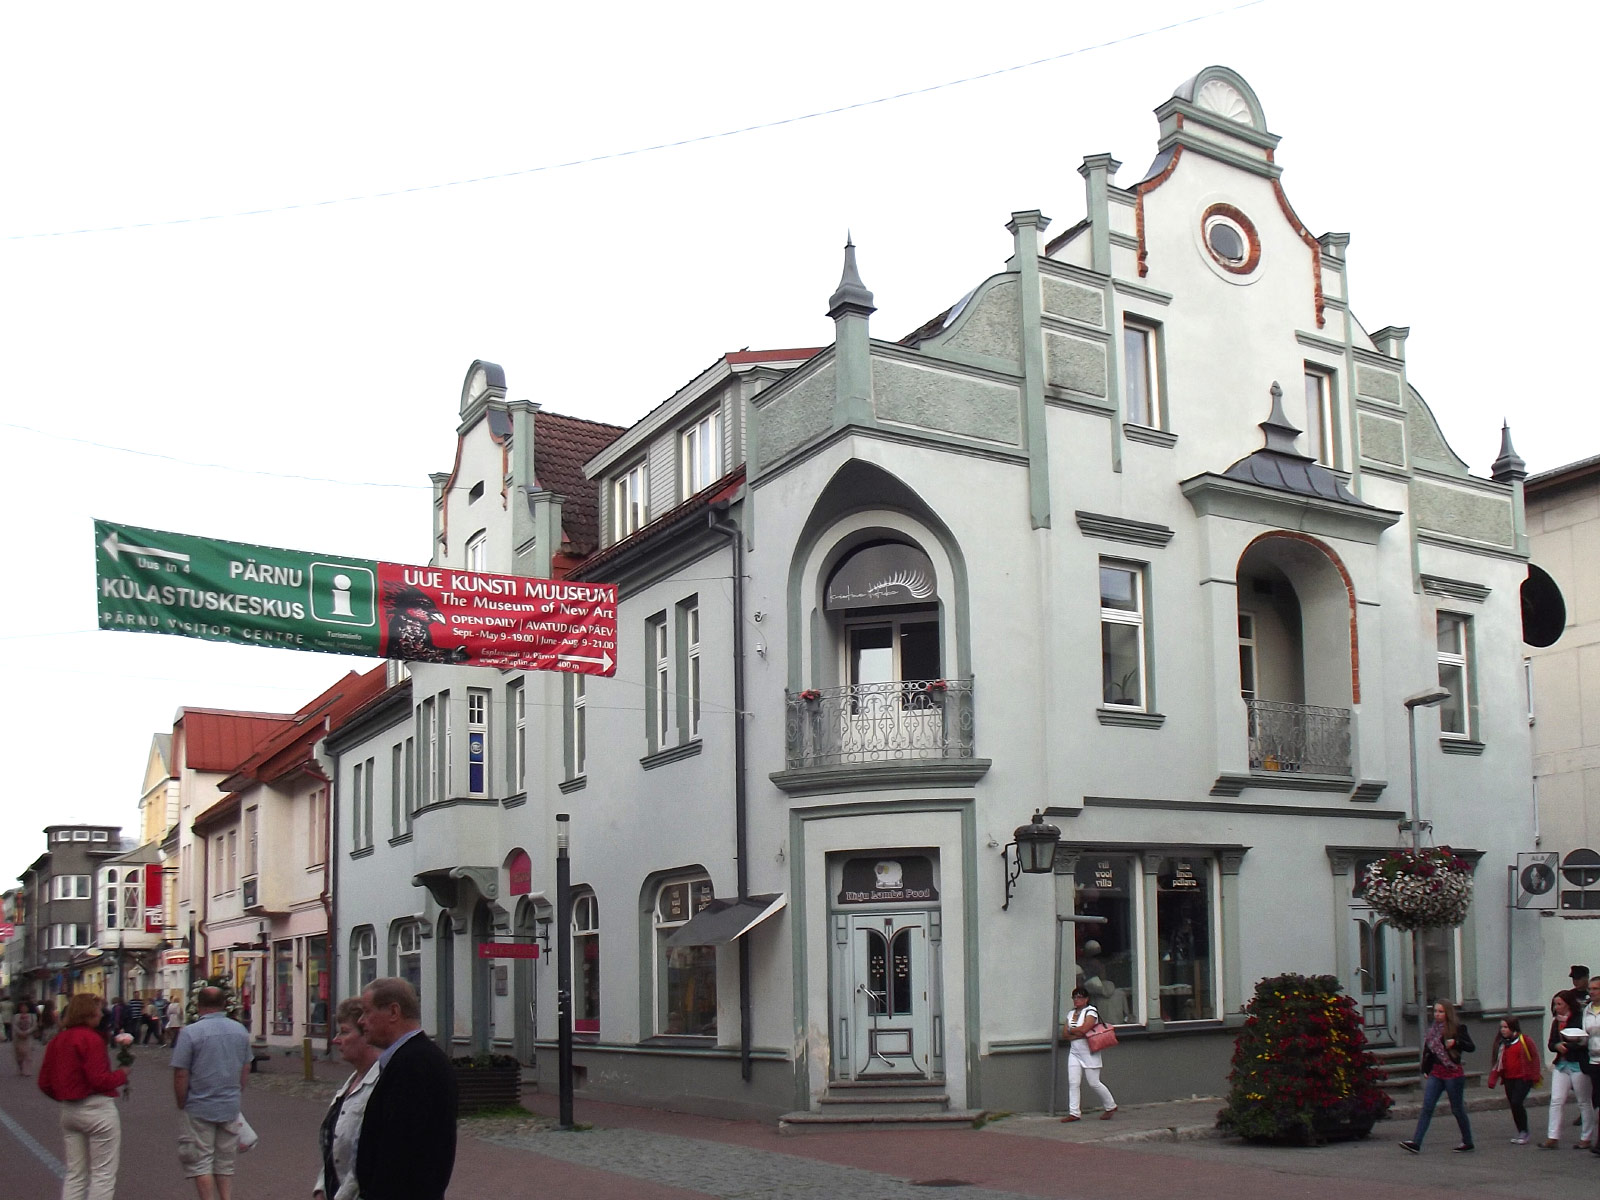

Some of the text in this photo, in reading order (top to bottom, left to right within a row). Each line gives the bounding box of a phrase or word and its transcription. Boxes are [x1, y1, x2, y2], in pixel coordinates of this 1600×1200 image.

[138, 557, 190, 574] Uus tn 4
[230, 559, 302, 587] PÄRNU
[103, 574, 305, 620] KÜLASTUSKESKUS
[404, 569, 615, 604] UUE KUNSTI MUUSEUM
[440, 592, 614, 619] The Museum of New Art
[243, 628, 304, 644] CENTRE
[451, 614, 483, 625] OPEN
[485, 617, 517, 629] DAILY
[525, 620, 567, 633] AVATUD
[568, 625, 587, 634] IGA
[588, 623, 614, 637] PÄEV
[479, 630, 499, 643] May
[540, 635, 558, 646] June
[557, 660, 571, 668] 400
